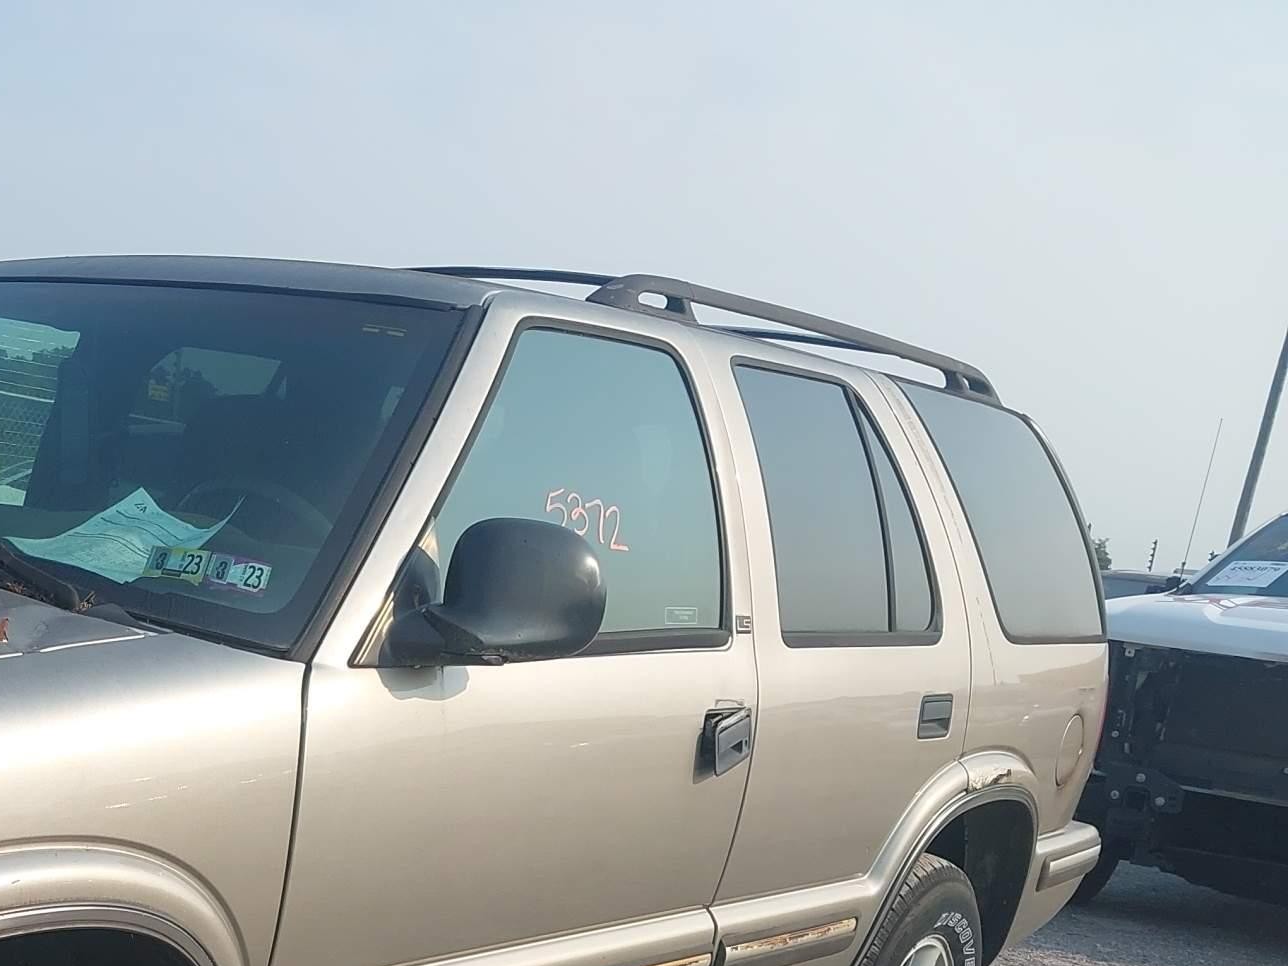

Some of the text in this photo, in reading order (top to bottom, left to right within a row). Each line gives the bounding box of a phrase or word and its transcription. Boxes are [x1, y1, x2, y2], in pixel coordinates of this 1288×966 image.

[546, 488, 630, 552] 5372
[183, 553, 203, 575] 23
[243, 565, 264, 589] 23
